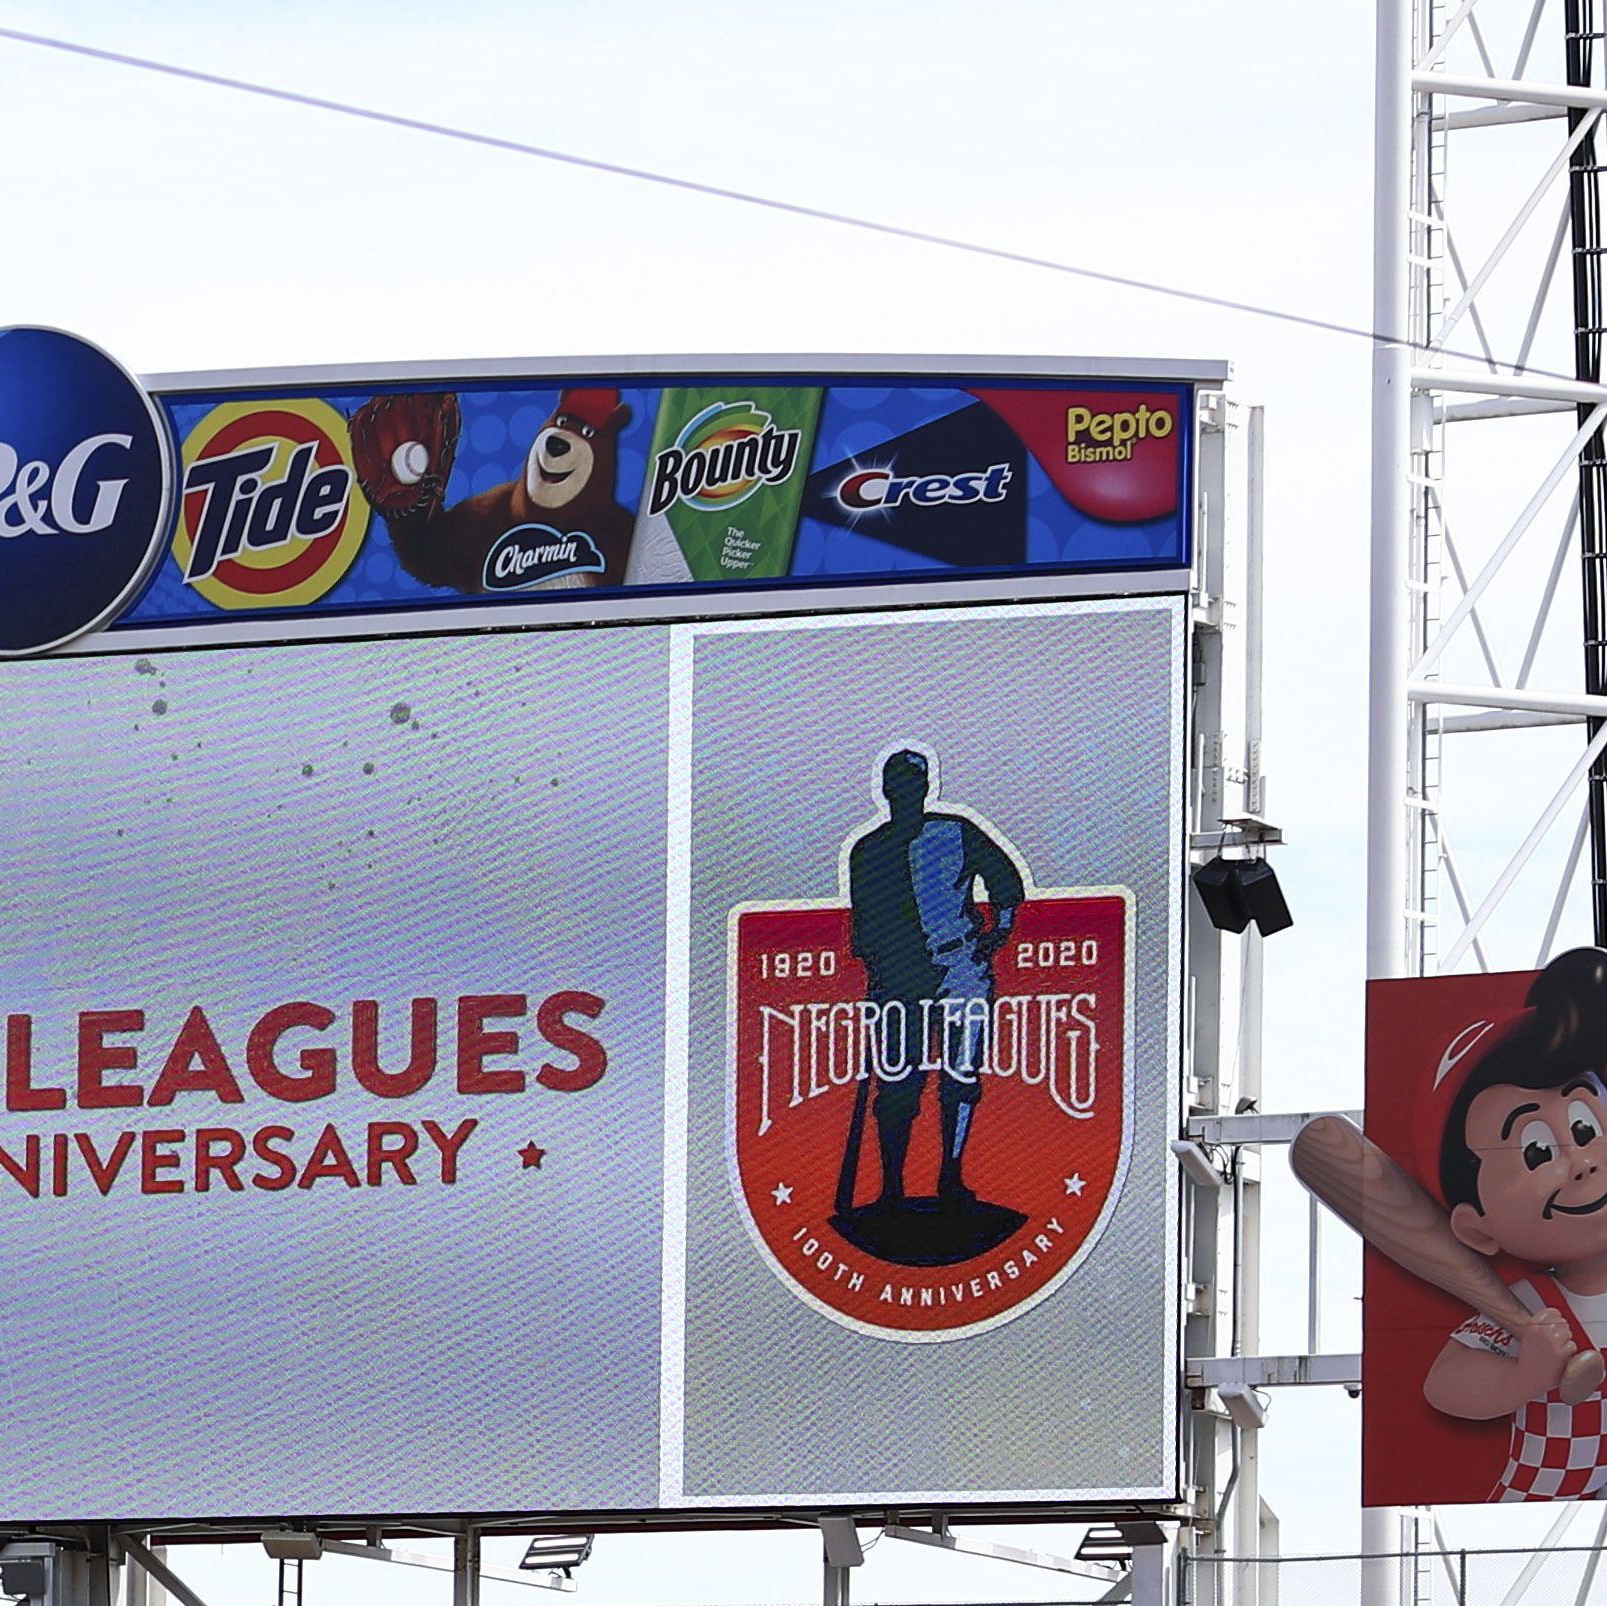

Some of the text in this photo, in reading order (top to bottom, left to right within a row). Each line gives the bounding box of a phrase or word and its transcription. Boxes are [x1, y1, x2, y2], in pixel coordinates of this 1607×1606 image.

[1066, 404, 1174, 444] Pepto
[649, 423, 804, 516] Bounty
[1066, 441, 1136, 464] Bismol
[837, 463, 1013, 510] Crest
[181, 440, 352, 583] Tide
[728, 526, 745, 538] The
[495, 537, 577, 578] Charmin
[722, 547, 753, 559] Picker
[724, 536, 762, 550] Quicker
[760, 939, 1099, 979] 1920 2020
[5, 990, 609, 1111] LEAGUES
[758, 993, 1101, 1136] NEGRO LEAGUES
[792, 1217, 1066, 1307] 100TH ANNIVERSARY
